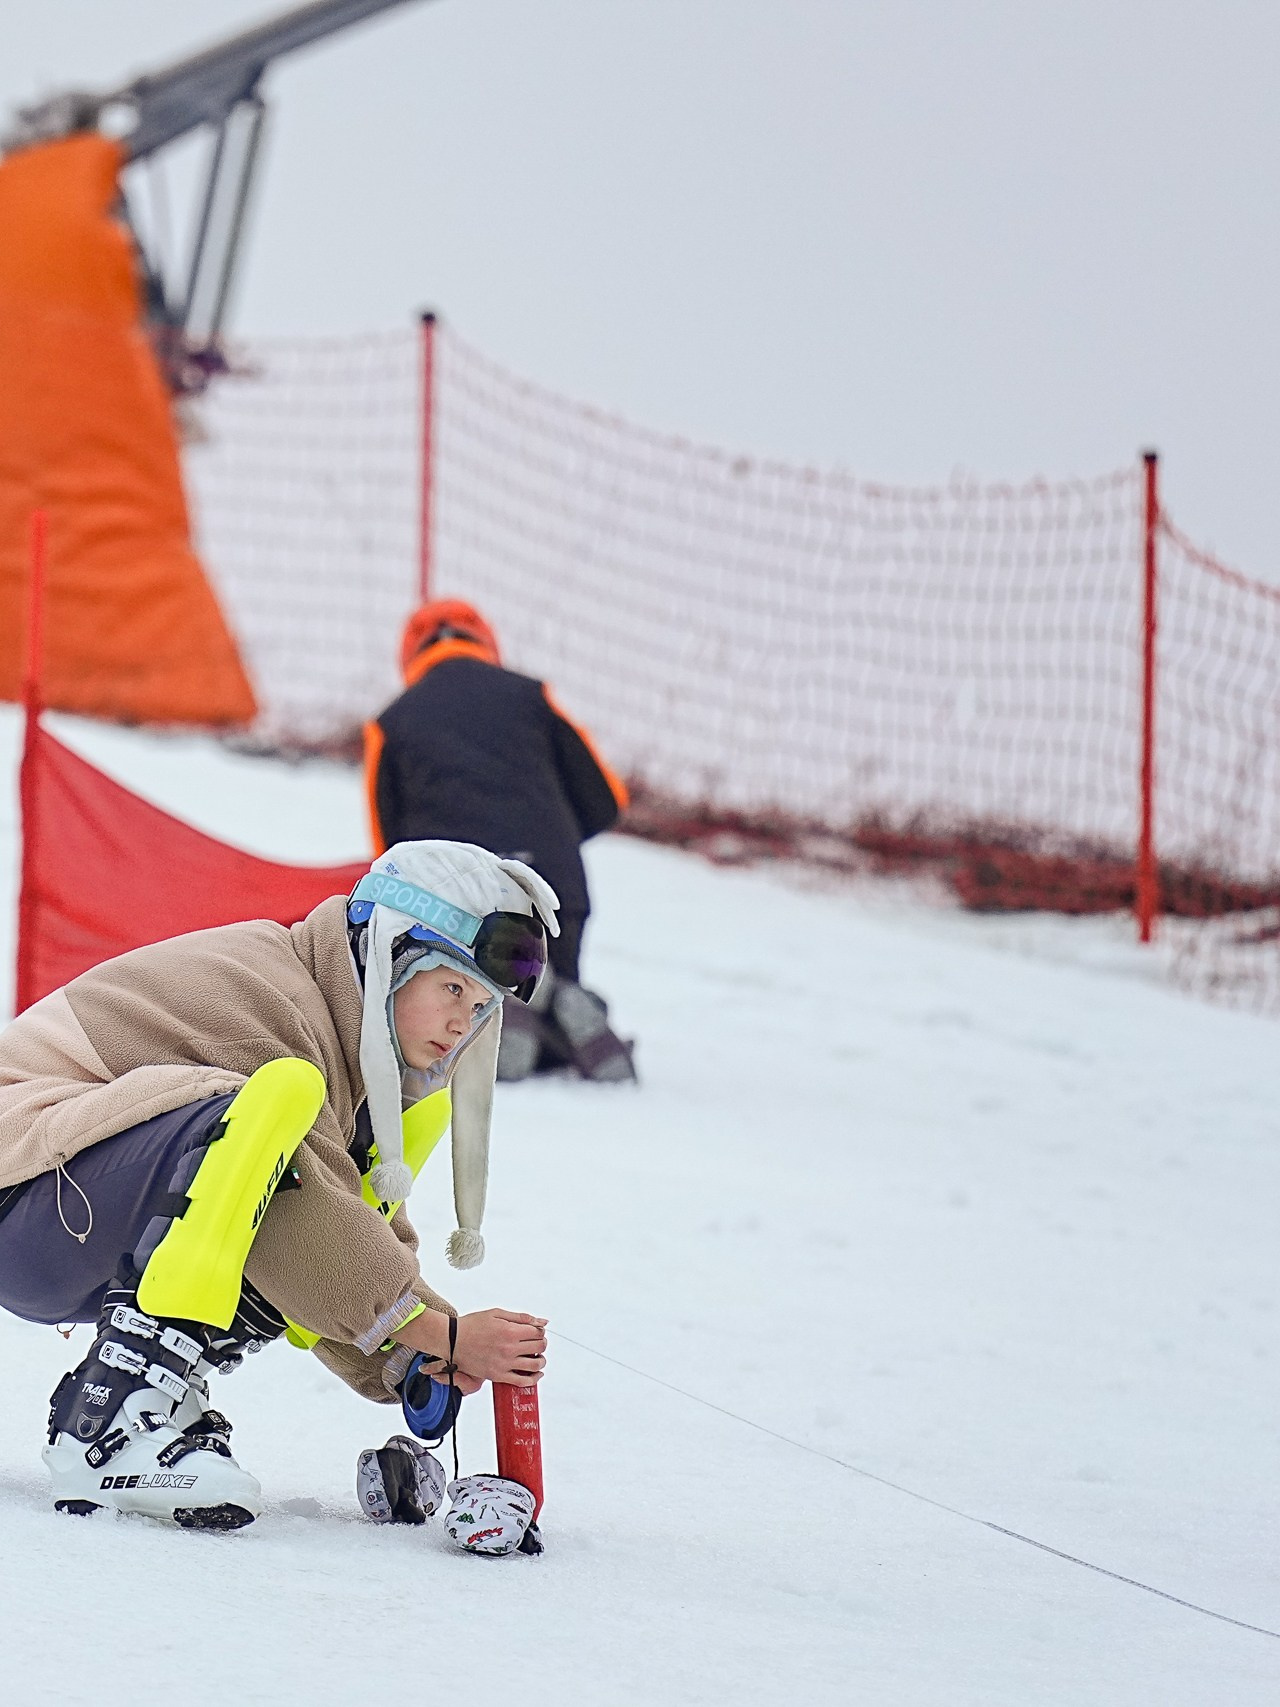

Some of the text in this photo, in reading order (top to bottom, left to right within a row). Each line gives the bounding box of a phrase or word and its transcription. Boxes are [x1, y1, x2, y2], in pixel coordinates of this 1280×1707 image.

[370, 876, 464, 933] SPORTS
[81, 1382, 113, 1398] TRACK
[99, 1474, 198, 1490] DEELUXE
